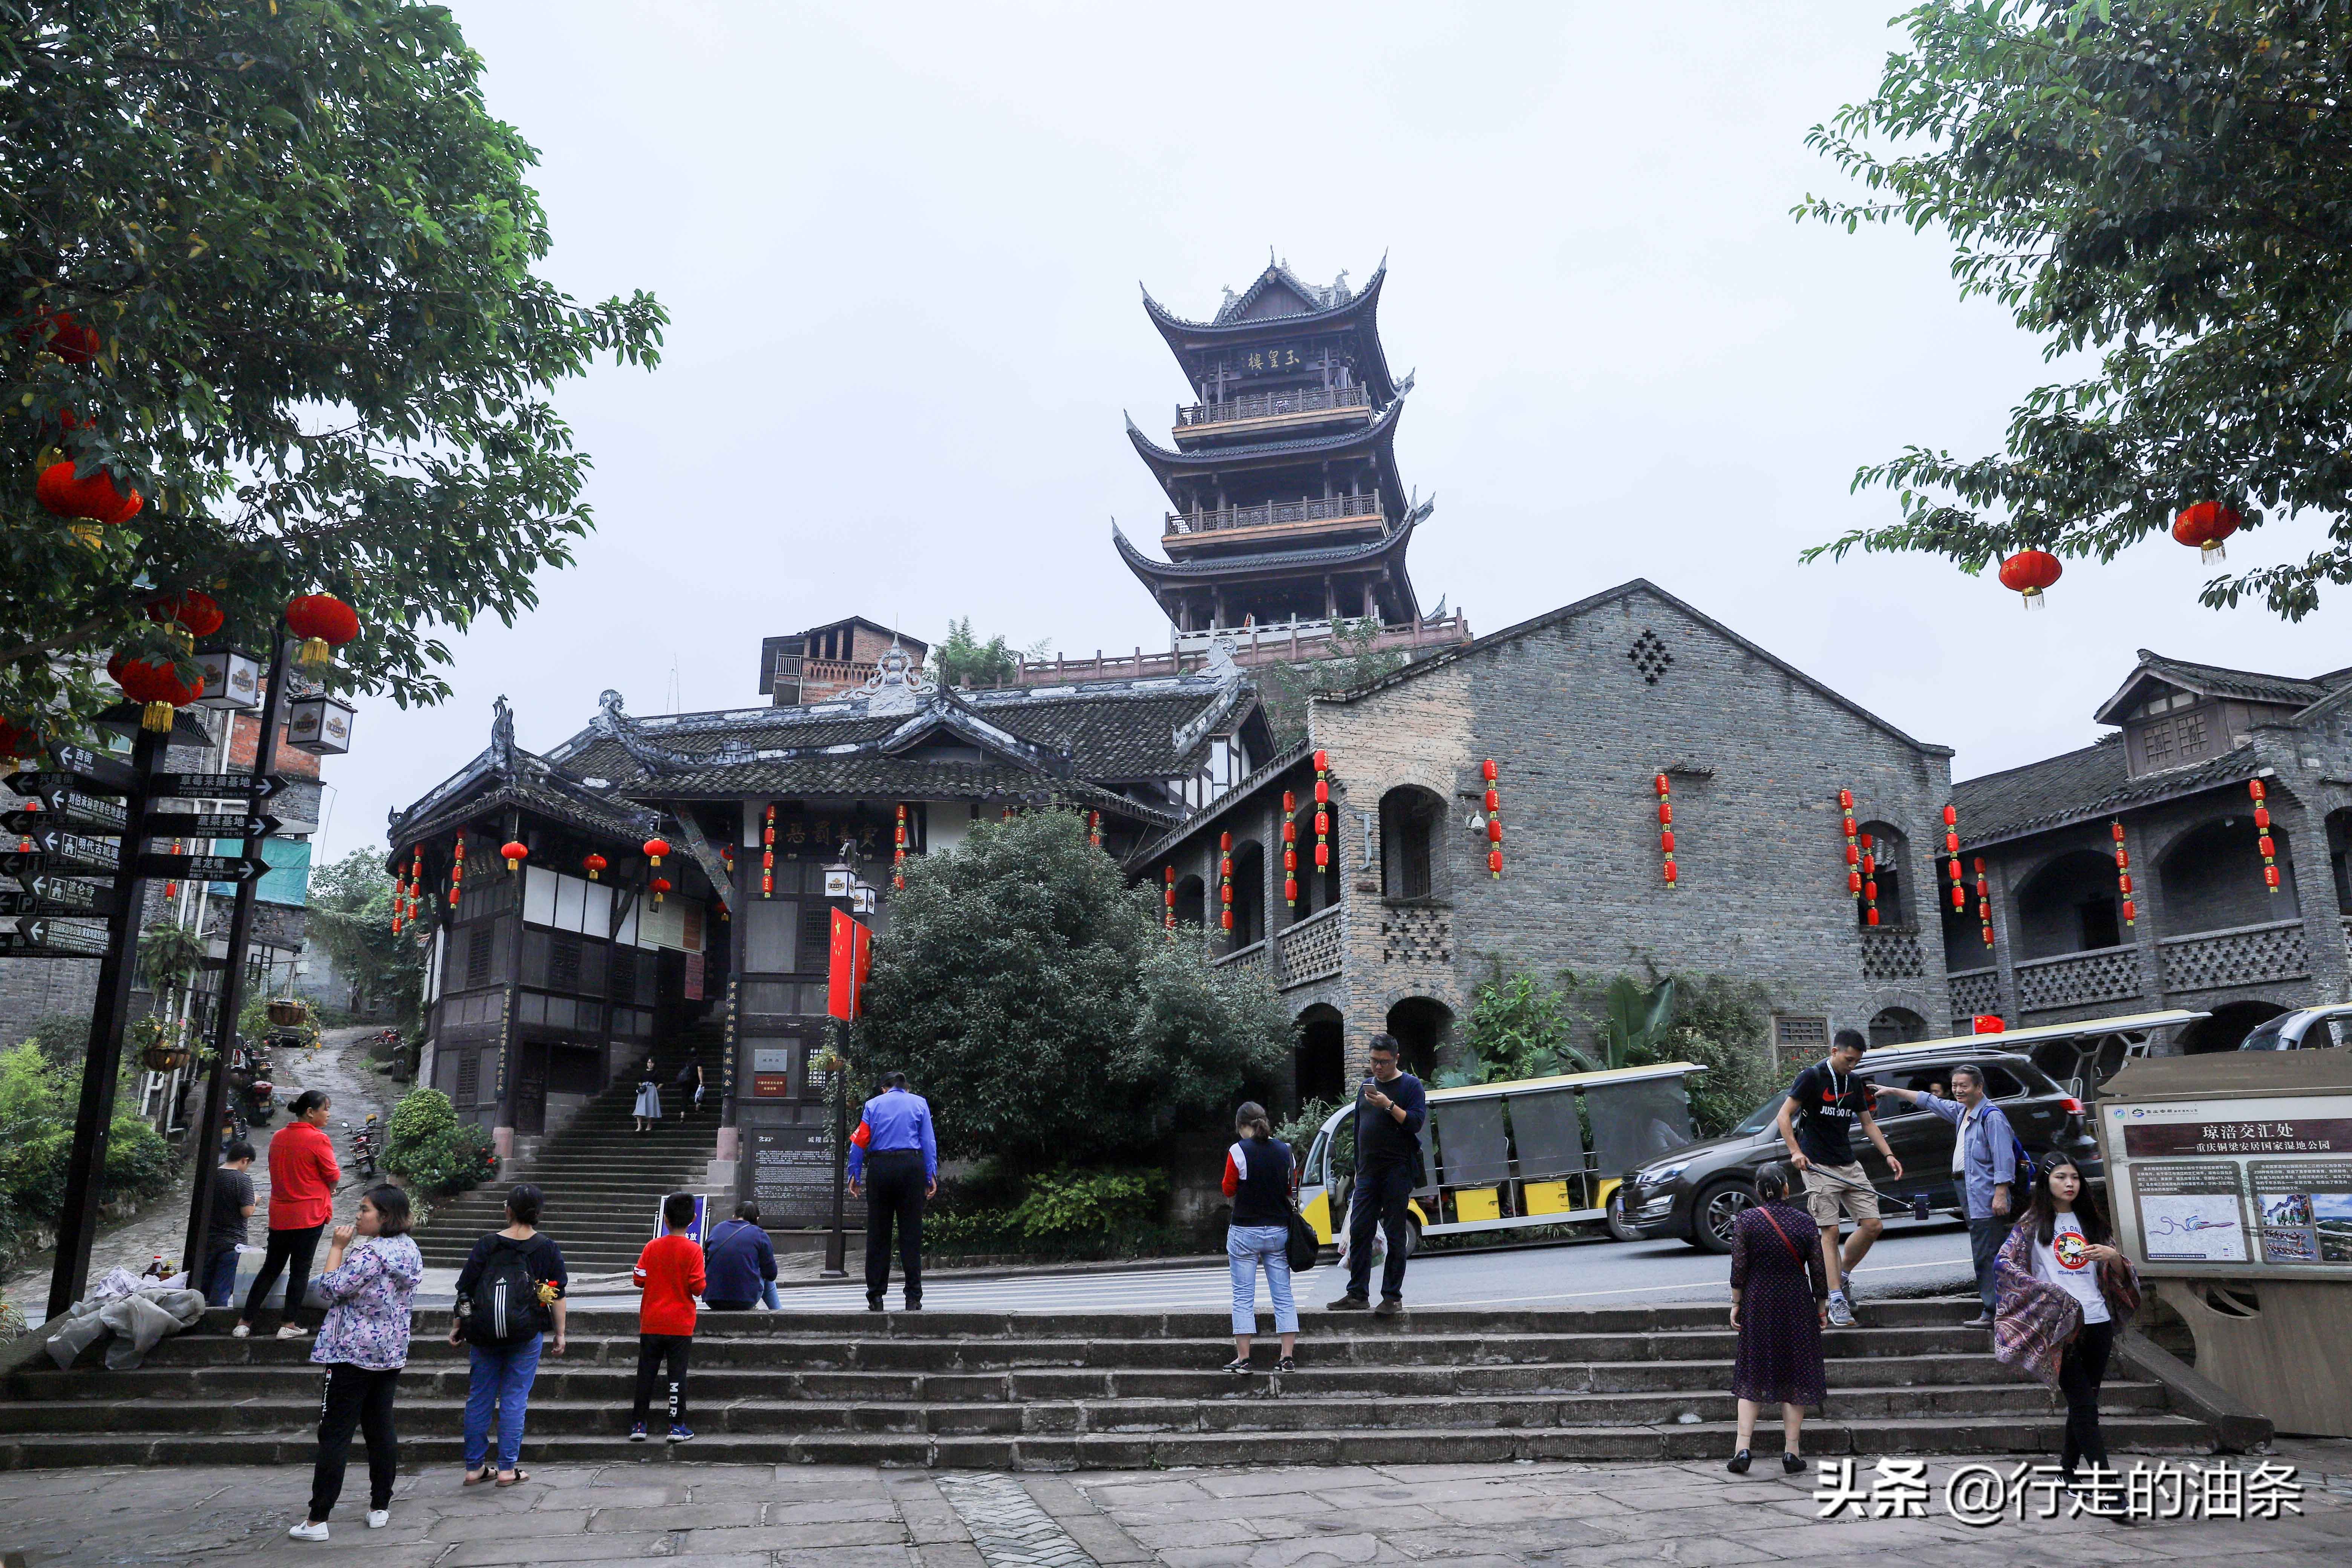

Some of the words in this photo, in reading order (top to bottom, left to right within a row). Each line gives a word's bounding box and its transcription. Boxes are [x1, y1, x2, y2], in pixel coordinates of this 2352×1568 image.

[1248, 349, 1300, 370] 玉皇樓
[76, 748, 93, 764] 西街
[181, 775, 250, 787] 草莓采摘基地
[198, 816, 244, 827] 蔬菜基地
[78, 838, 119, 859] 明代古城墙
[191, 858, 225, 869] 黑龙嘴
[67, 880, 95, 897] 波仑寺
[1820, 1106, 1836, 1116] JUST
[1836, 1108, 1845, 1117] DO
[2202, 1123, 2294, 1139] 琼涪交汇处
